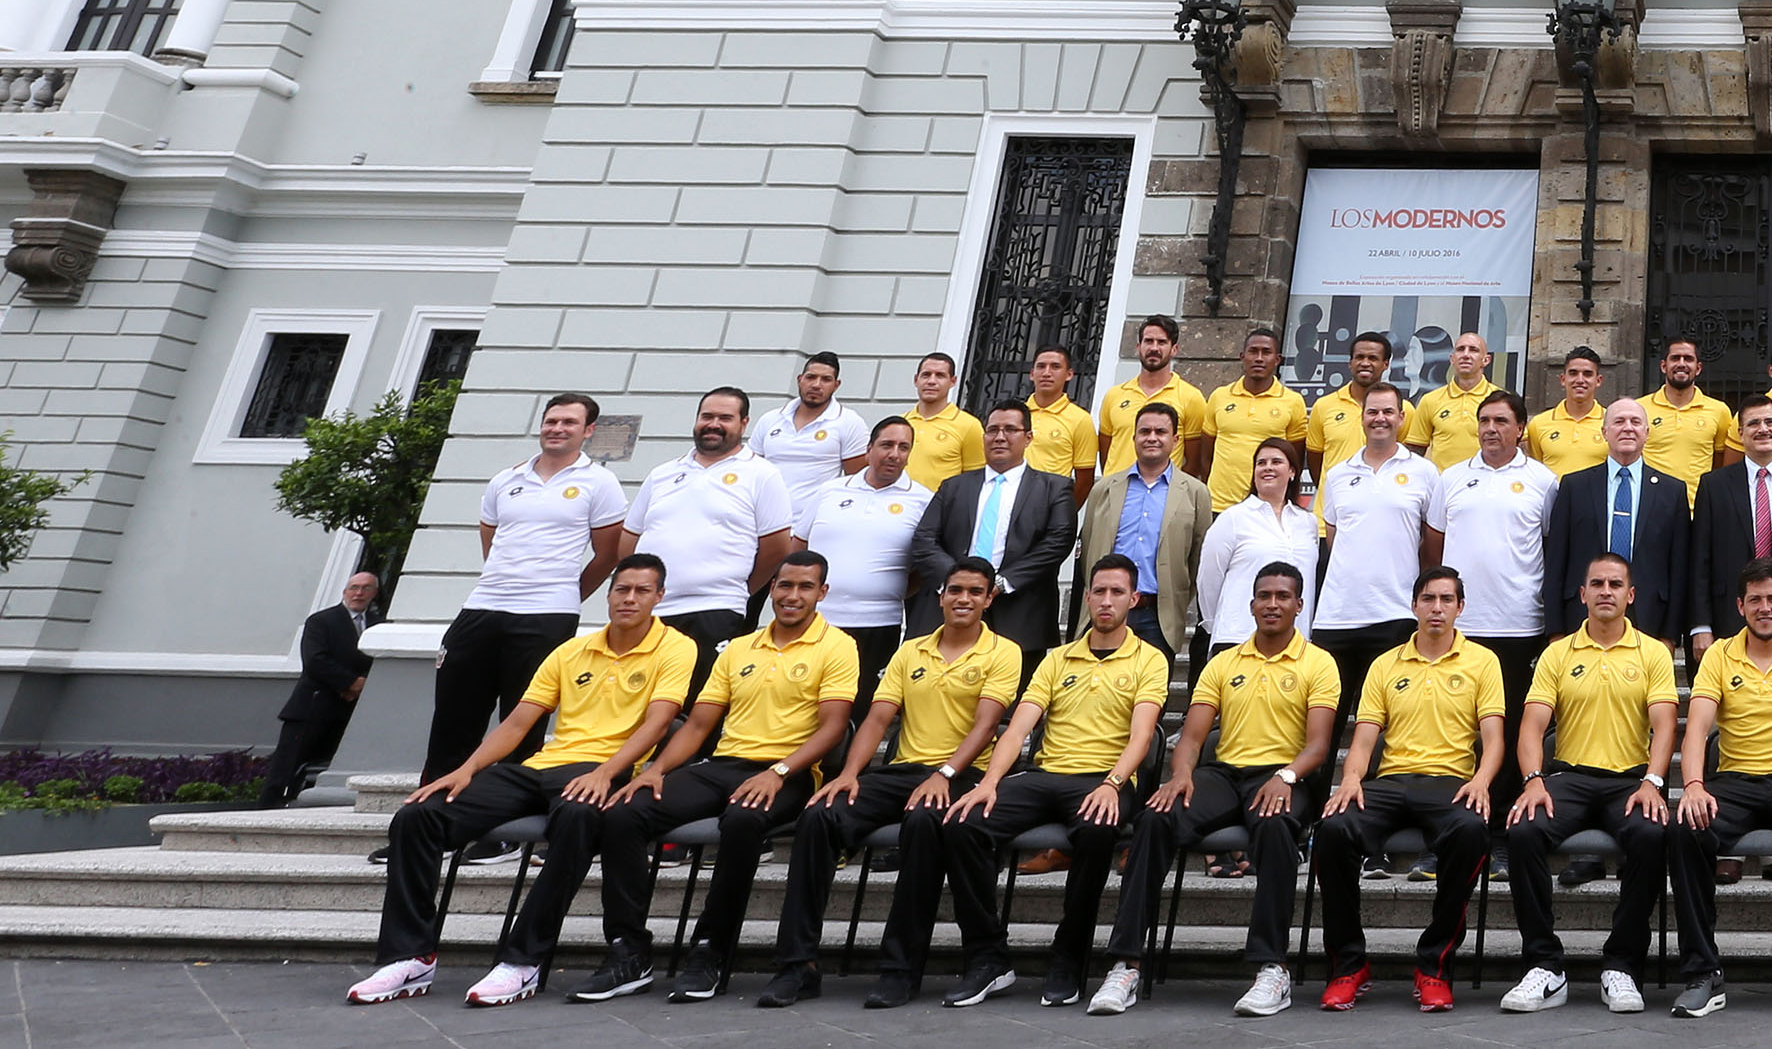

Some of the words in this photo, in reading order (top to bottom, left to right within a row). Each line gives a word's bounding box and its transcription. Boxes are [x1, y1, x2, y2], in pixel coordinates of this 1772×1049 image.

[1330, 207, 1506, 230] LOSMODERNOS
[1378, 250, 1400, 258] ABRIL
[1408, 250, 1417, 258] 10
[1418, 250, 1440, 259] JULIO
[1443, 250, 1461, 258] 2016
